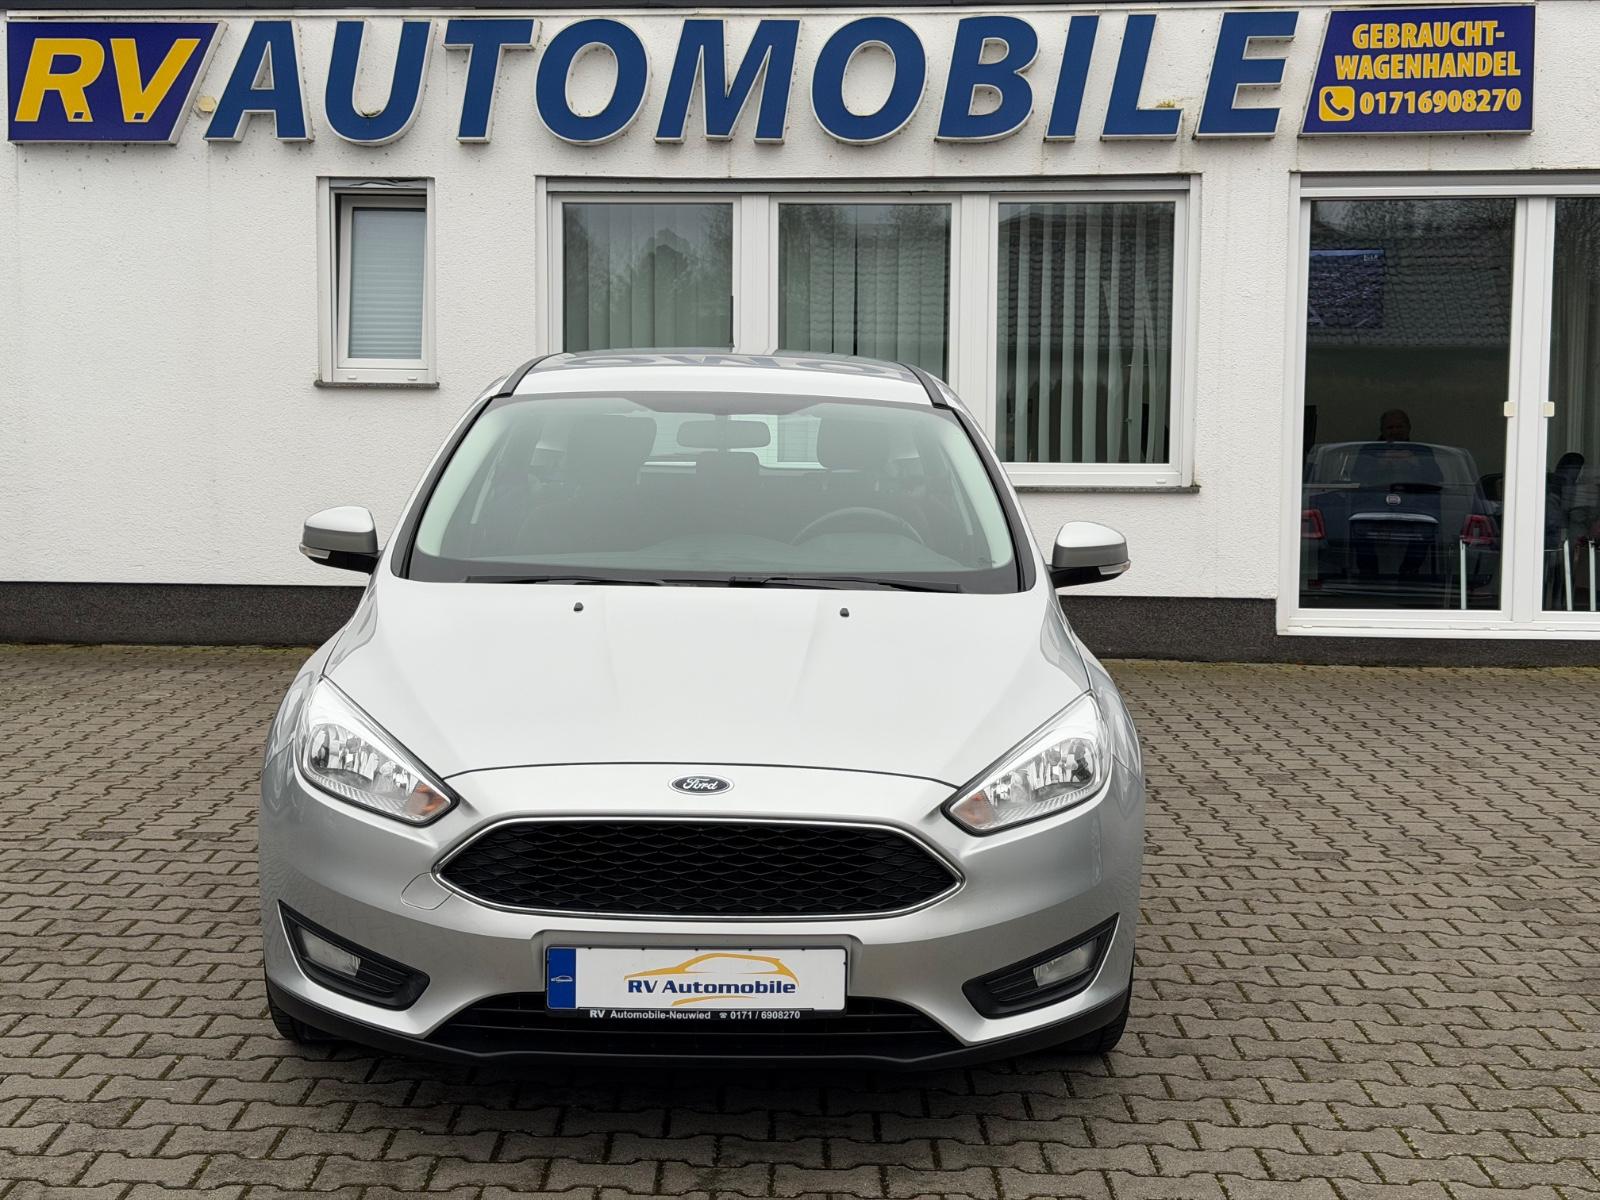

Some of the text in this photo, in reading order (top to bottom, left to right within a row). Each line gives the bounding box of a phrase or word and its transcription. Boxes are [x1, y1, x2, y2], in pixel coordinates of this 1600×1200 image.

[1352, 20, 1505, 49] GEBRAUCHT-
[204, 11, 1300, 146] AUTOMOBILE
[1334, 51, 1521, 80] WAGENHANDEL
[14, 37, 201, 124] RV
[1359, 88, 1522, 115] 01716908270
[682, 778, 719, 790] Ford
[627, 979, 797, 995] RV Automobile
[589, 1009, 606, 1019] RV
[610, 1010, 712, 1020] Automobile-Neuwied
[729, 1010, 752, 1020] 0171
[760, 1010, 801, 1020] 6908270
